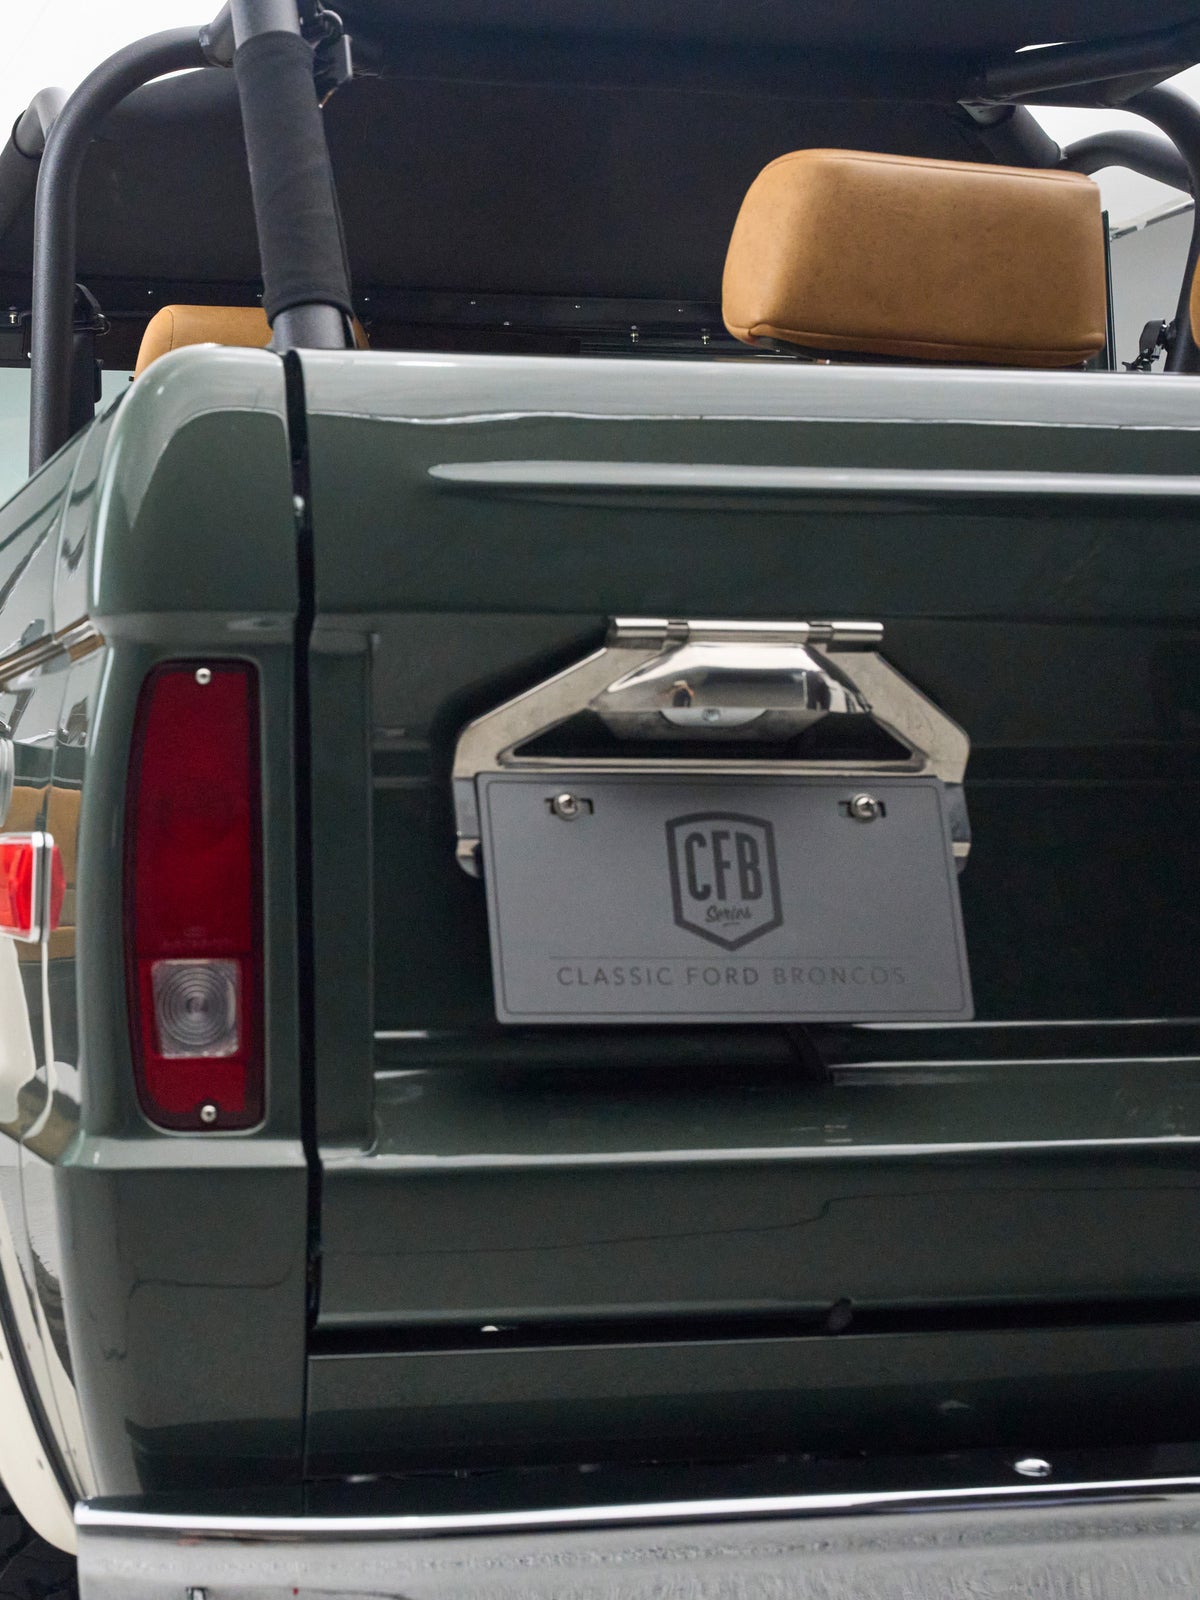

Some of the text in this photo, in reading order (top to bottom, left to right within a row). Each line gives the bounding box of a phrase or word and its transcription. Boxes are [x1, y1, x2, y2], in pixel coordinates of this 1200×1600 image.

[684, 830, 763, 901] CFB
[705, 904, 752, 926] Series
[556, 965, 906, 986] CLASSIC FORD BRONCOS
